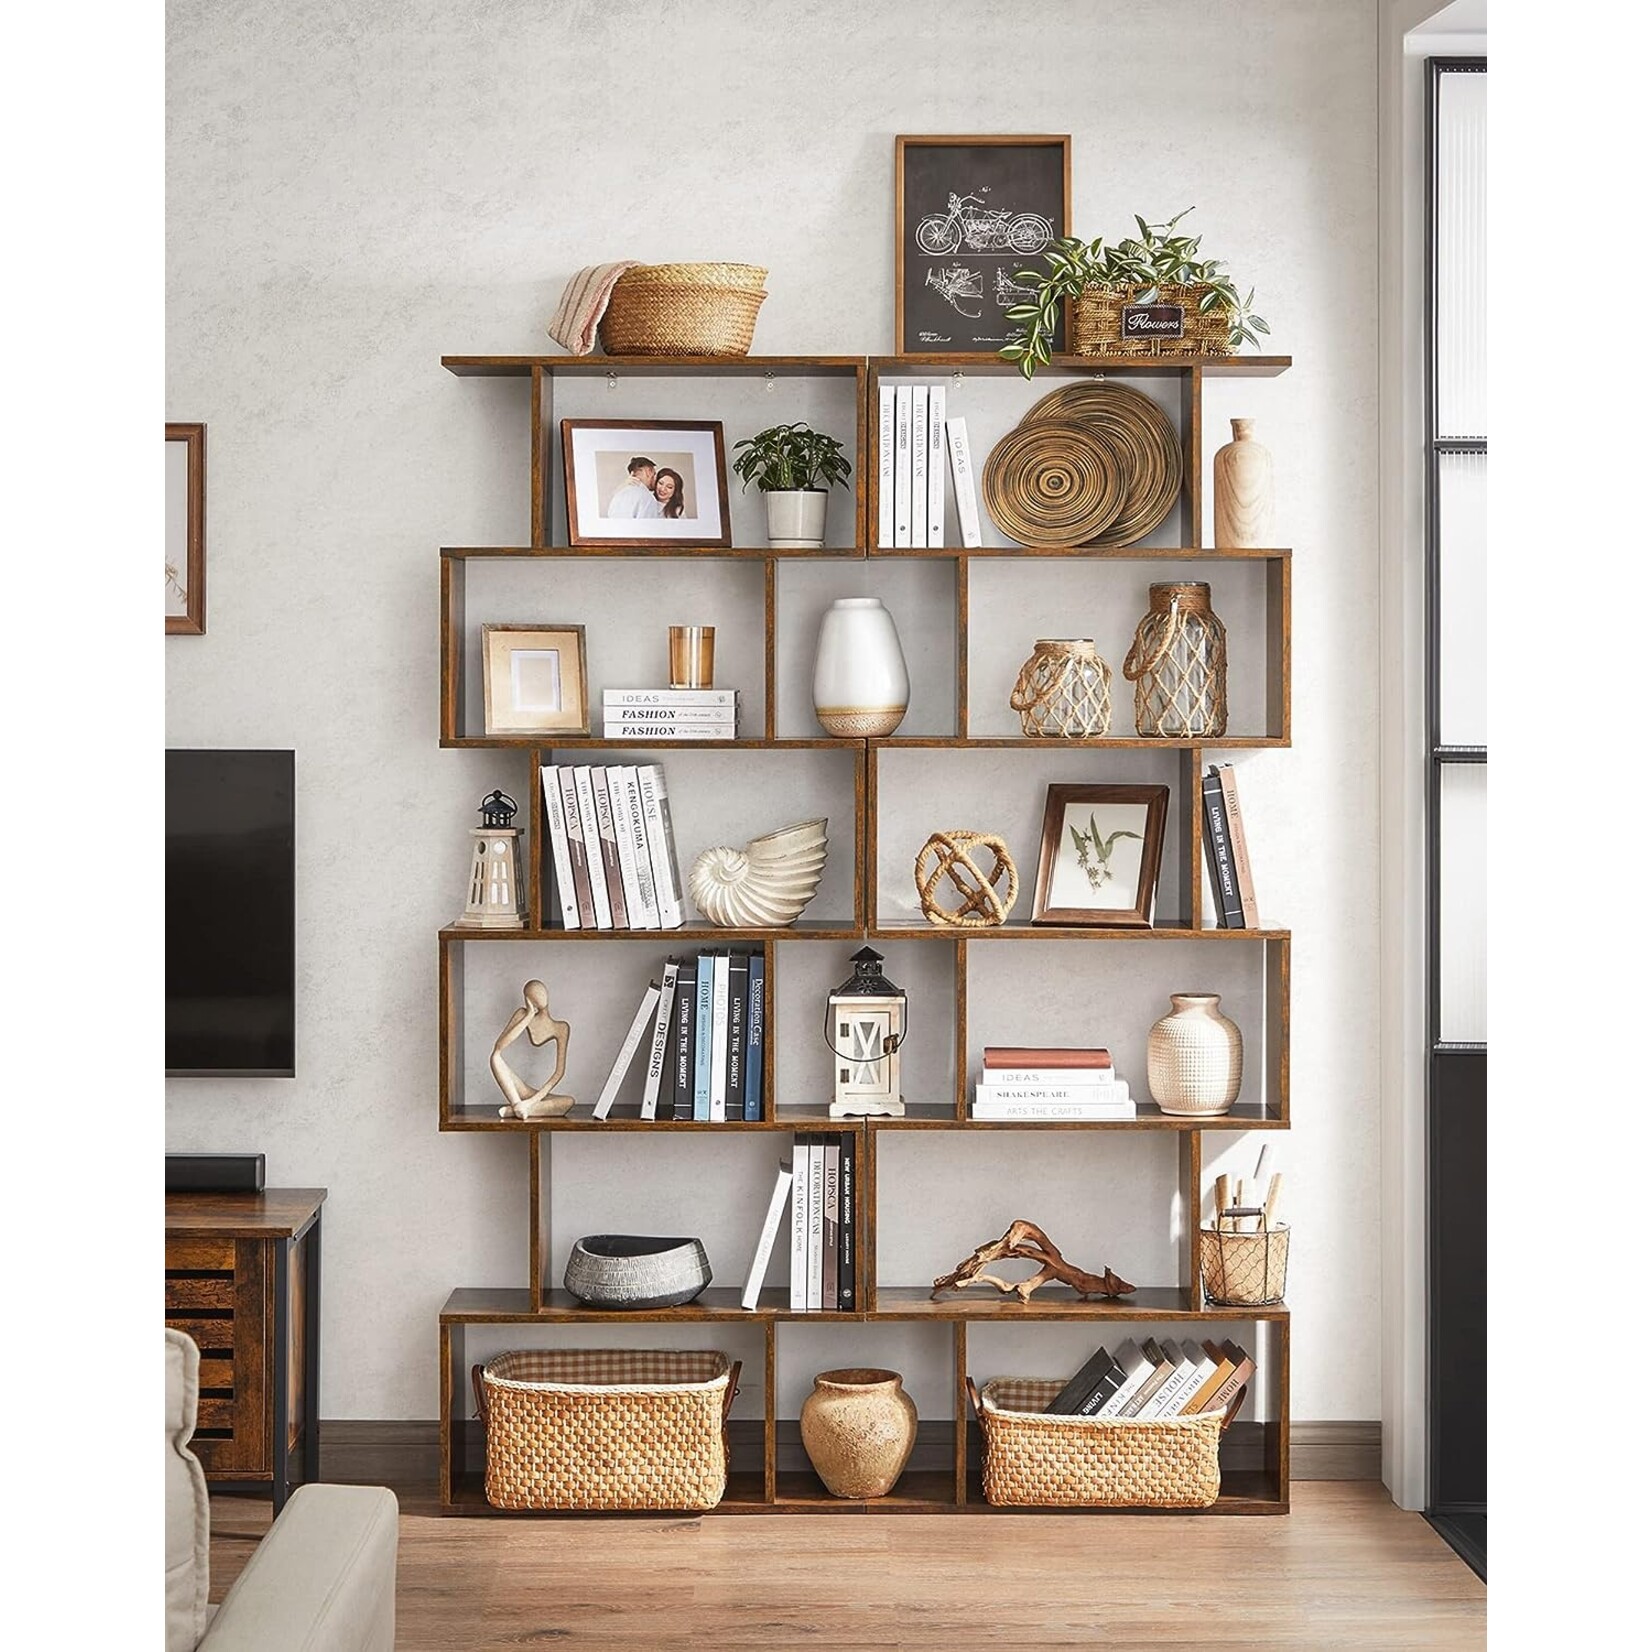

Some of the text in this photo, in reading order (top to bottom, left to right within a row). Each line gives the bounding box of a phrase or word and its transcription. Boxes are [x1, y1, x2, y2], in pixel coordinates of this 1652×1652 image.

[1128, 313, 1179, 330] Flowers
[954, 437, 966, 474] IDEAS
[622, 710, 676, 718] FASHION
[622, 727, 676, 735] FASHION
[565, 788, 577, 831] HOPSCA
[598, 788, 610, 831] HOPSCA
[627, 782, 643, 849] KENGOKUMA
[642, 781, 657, 822] HOUSE
[1227, 790, 1239, 819] HOME
[1211, 807, 1233, 896] LIVING IN THE MOMENT
[700, 981, 709, 1010] HOME
[716, 984, 726, 1026] PHOTOS
[753, 979, 763, 1024] Decoration
[650, 1022, 666, 1078] DESIGNS
[679, 998, 689, 1088] LIVING IN THE MOMENT
[731, 998, 741, 1088] LIVING IN THE MOMENT
[752, 1025, 762, 1045] Case
[812, 1161, 821, 1216] DECORATION
[828, 1168, 836, 1209] HOPSCA
[1084, 1392, 1103, 1414] LIVING
[1155, 1374, 1184, 1408] HOUSE
[1217, 1379, 1240, 1404] HOME
